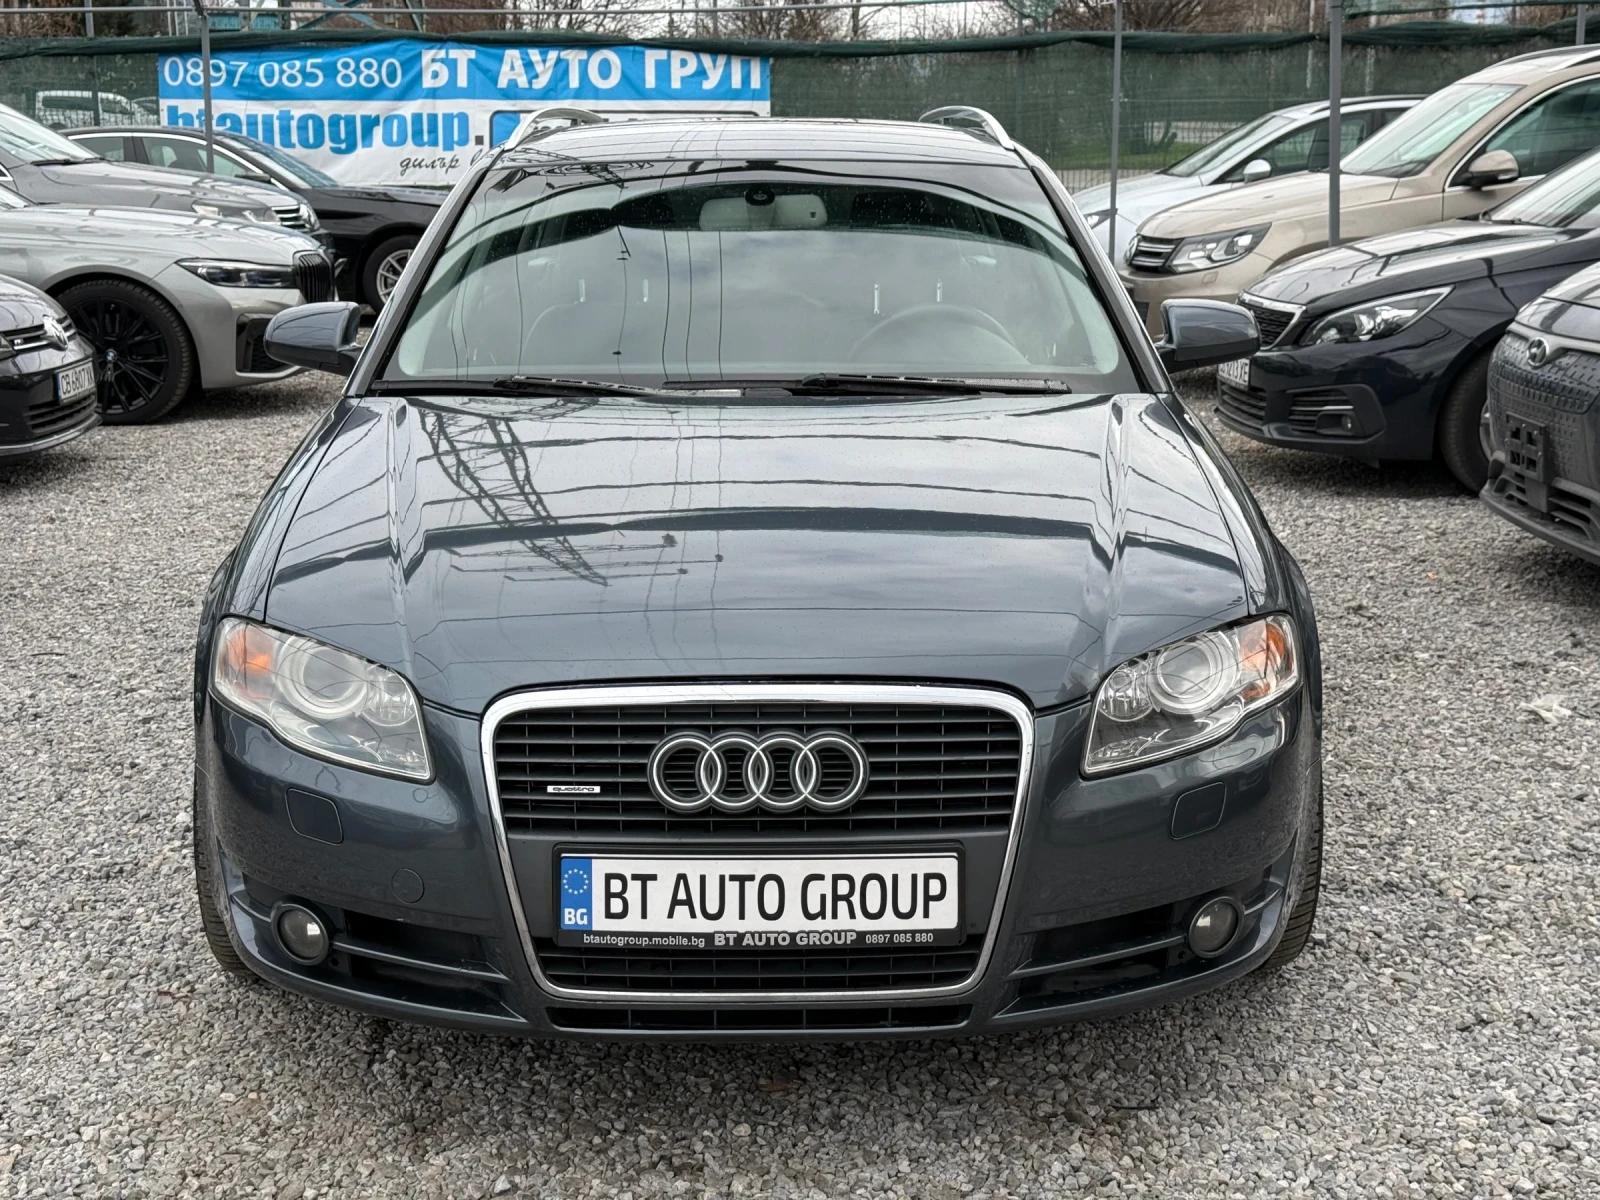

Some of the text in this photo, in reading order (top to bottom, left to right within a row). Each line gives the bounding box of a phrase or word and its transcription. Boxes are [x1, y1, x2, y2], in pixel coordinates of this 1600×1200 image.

[163, 48, 761, 90] 0897 085 880 БТ АУТО ГРУП
[552, 786, 595, 794] quattro
[604, 872, 947, 921] BT AUTO GROUP
[563, 907, 588, 926] BG
[583, 931, 934, 947] btautogroup.mobile.bg BT AUTO GROUP 0897 085 880
